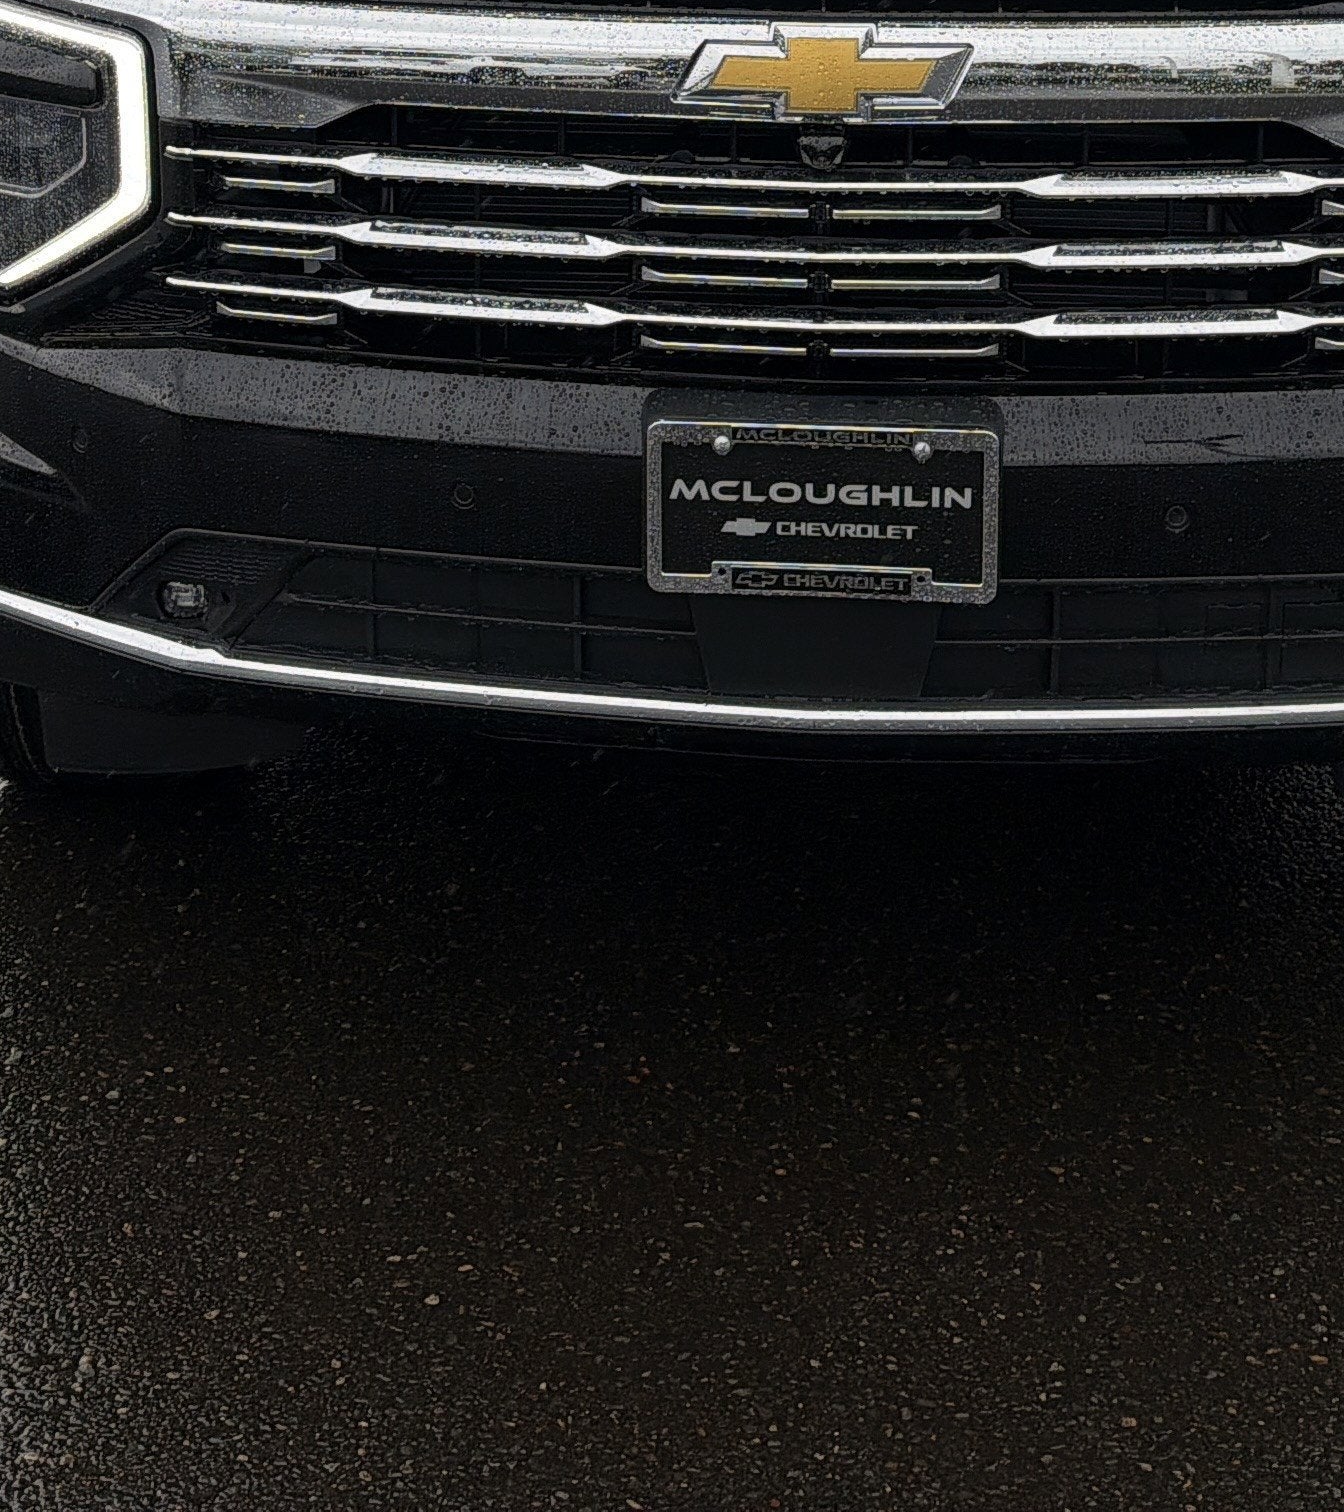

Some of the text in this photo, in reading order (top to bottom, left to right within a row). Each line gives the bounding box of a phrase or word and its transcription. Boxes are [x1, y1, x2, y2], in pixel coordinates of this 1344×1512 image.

[736, 429, 911, 445] MCLOUGHLIN
[669, 478, 973, 509] MCLOUGHLIN
[776, 521, 919, 540] CHEVROLET
[784, 574, 908, 591] CHEVROLET
